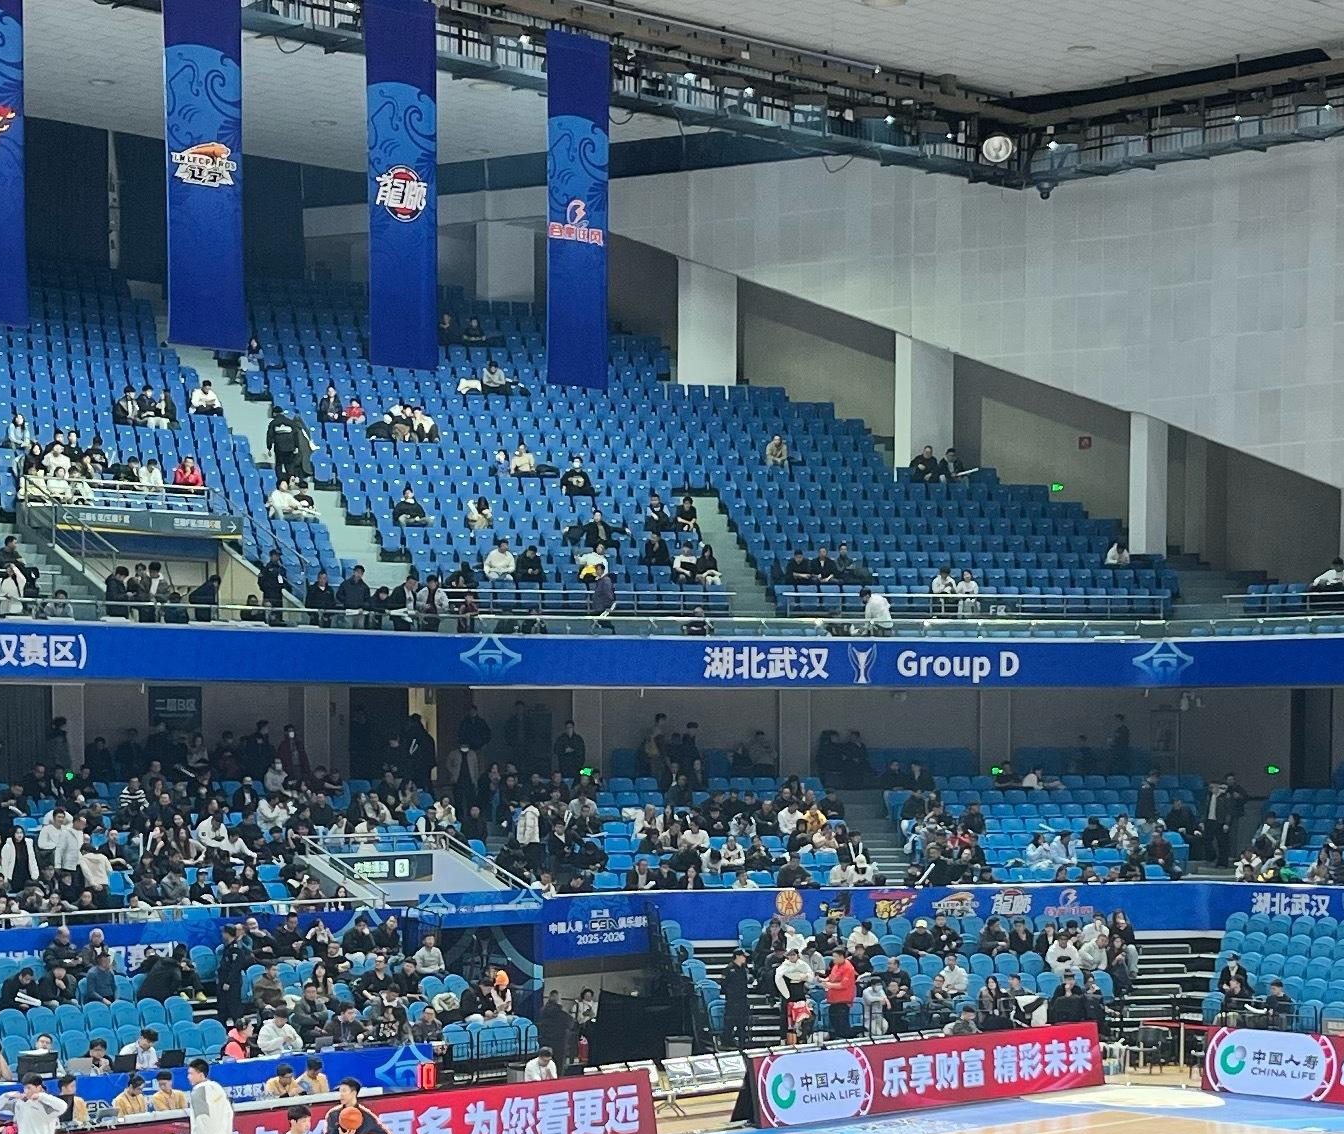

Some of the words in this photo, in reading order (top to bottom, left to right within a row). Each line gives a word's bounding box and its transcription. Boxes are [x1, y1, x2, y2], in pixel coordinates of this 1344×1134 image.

[702, 645, 829, 679] 湖北武汉
[897, 650, 990, 683] Group
[999, 651, 1021, 678] D
[1251, 892, 1330, 918] 湖北武汉
[576, 931, 626, 945] 2025-2026
[881, 1048, 986, 1098] 乐享财富
[993, 1036, 1093, 1085] 精彩未来
[1252, 1049, 1319, 1070] 中国人寿
[801, 1068, 862, 1090] 中国人寿
[1251, 1066, 1287, 1079] CHINA
[1290, 1068, 1317, 1081] LIFE
[802, 1090, 837, 1105] CHINA
[839, 1087, 862, 1102] LIFE
